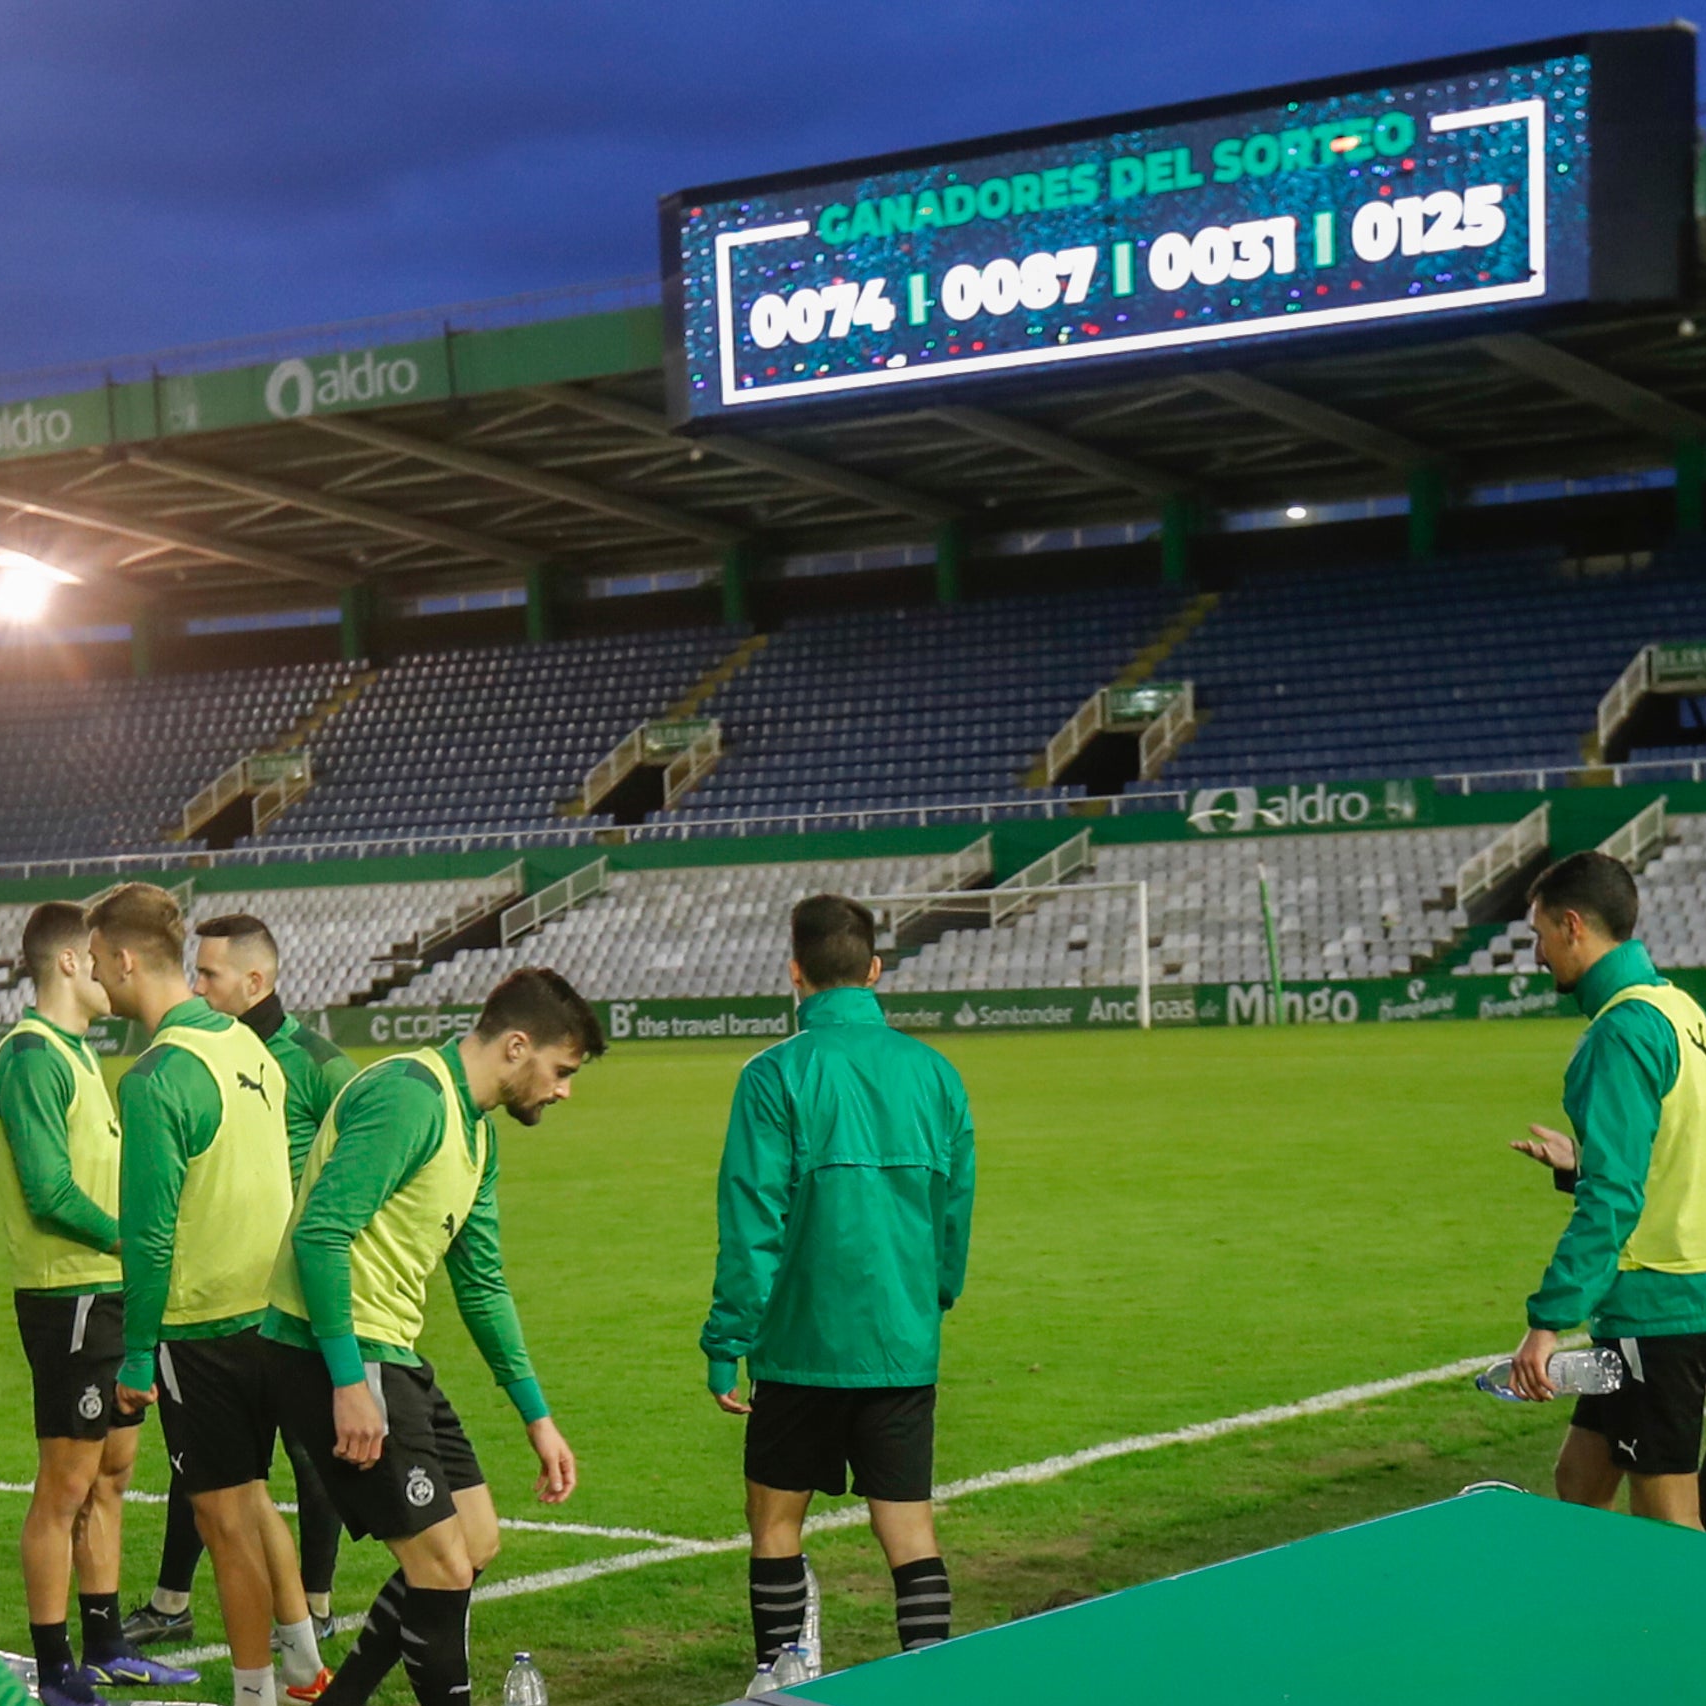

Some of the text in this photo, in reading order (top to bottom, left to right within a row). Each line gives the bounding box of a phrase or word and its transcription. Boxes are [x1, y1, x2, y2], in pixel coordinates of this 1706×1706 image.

[817, 111, 1417, 246] GANADORES DEL SORTEO
[749, 183, 1507, 350] 0074 0087 0031 0125
[317, 351, 419, 405] aldro
[1264, 782, 1369, 826] aldro
[394, 1013, 482, 1039] COPS
[637, 1014, 668, 1036] the
[671, 1013, 727, 1035] travel
[729, 1011, 789, 1034] brand
[979, 1003, 1073, 1026] Santander
[1088, 996, 1194, 1023] Ancoas
[1227, 983, 1359, 1026] Mingo
